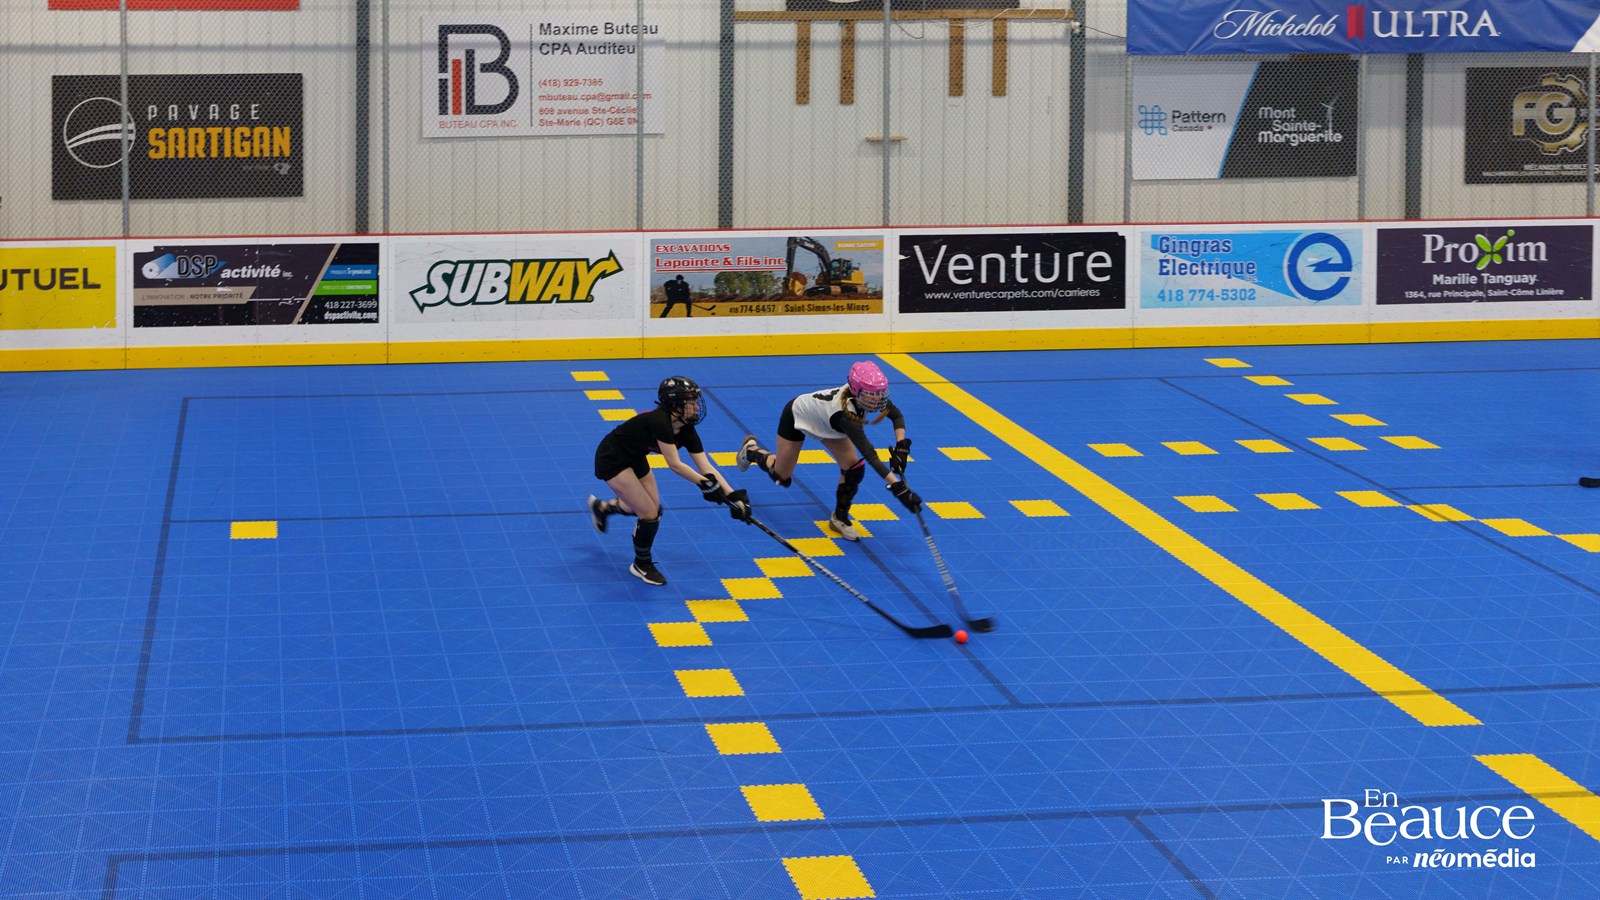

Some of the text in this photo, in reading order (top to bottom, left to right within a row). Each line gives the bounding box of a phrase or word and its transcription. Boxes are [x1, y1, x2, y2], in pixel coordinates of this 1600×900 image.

[539, 22, 658, 36] Maxime Buteau
[1213, 9, 1499, 39] Michelob ULTRA
[539, 41, 637, 55] CPA Auditeu
[538, 79, 561, 88] (418)
[538, 92, 652, 102] mbuteau.cpa@gmail.cm
[147, 103, 260, 121] PAVAGE
[557, 107, 589, 115] avenue
[1172, 110, 1226, 123] Pattern
[1258, 106, 1296, 119] Mont
[1512, 91, 1577, 136] FG
[439, 120, 477, 129] BUTEAU
[479, 120, 498, 128] CPA
[1172, 124, 1204, 132] Canada
[1272, 119, 1322, 131] Sainte-
[147, 126, 291, 159] SARTIGAN
[1258, 129, 1343, 146] Marguerite
[655, 243, 731, 253] EXCAVATIONS
[1159, 236, 1231, 257] Gingras
[176, 254, 218, 277] DSP
[220, 264, 281, 278] activité
[655, 256, 719, 269] Lapointe
[723, 256, 733, 266] &
[736, 256, 761, 266] Fils
[913, 245, 1112, 285] Venture
[1158, 255, 1256, 279] Électrique
[409, 249, 623, 313] SUBWAY
[1432, 272, 1537, 286] Marilie Tanguay
[213, 292, 243, 300] PRIORITÉ
[924, 287, 1101, 301] www.venturecarpets.com/carrieres
[1157, 288, 1256, 302] 418 774-5302
[1443, 289, 1486, 299] Principale,
[1487, 288, 1534, 297] Saint-Côme
[1536, 287, 1564, 296] Linière
[324, 300, 378, 309] 418 227-3699
[740, 304, 776, 313] 774-6457
[784, 303, 869, 313] Saint-Simon-les-Mines
[324, 311, 377, 321] dspactivite.com
